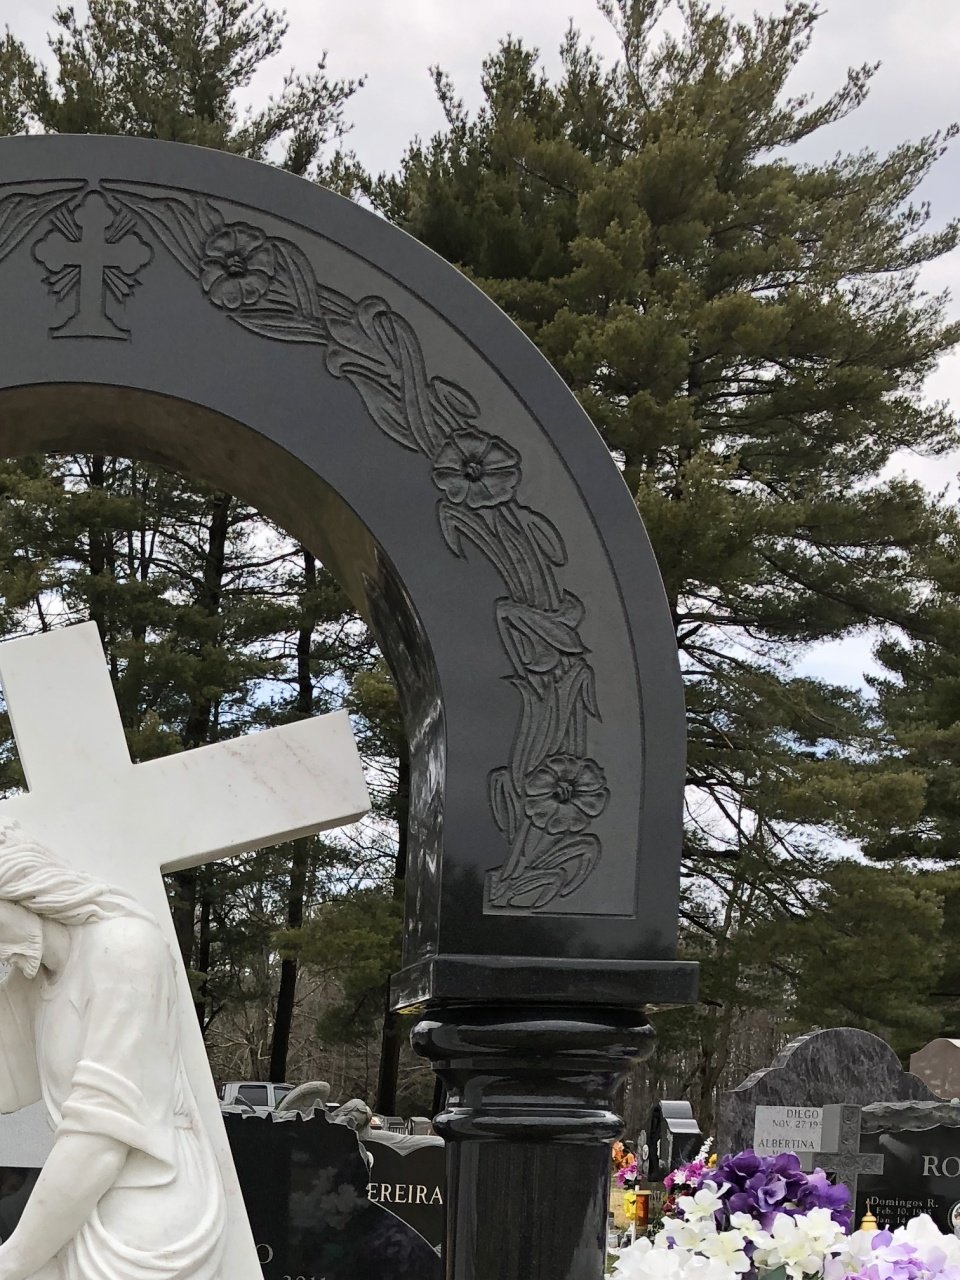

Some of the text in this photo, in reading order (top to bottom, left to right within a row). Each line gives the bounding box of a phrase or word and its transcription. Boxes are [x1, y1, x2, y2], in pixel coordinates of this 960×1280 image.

[786, 1109, 819, 1119] DIEGO
[758, 1139, 815, 1149] ALBERTINA
[922, 1155, 960, 1178] RO
[368, 1182, 443, 1205] EREIRA
[871, 1196, 923, 1208] Domingos
